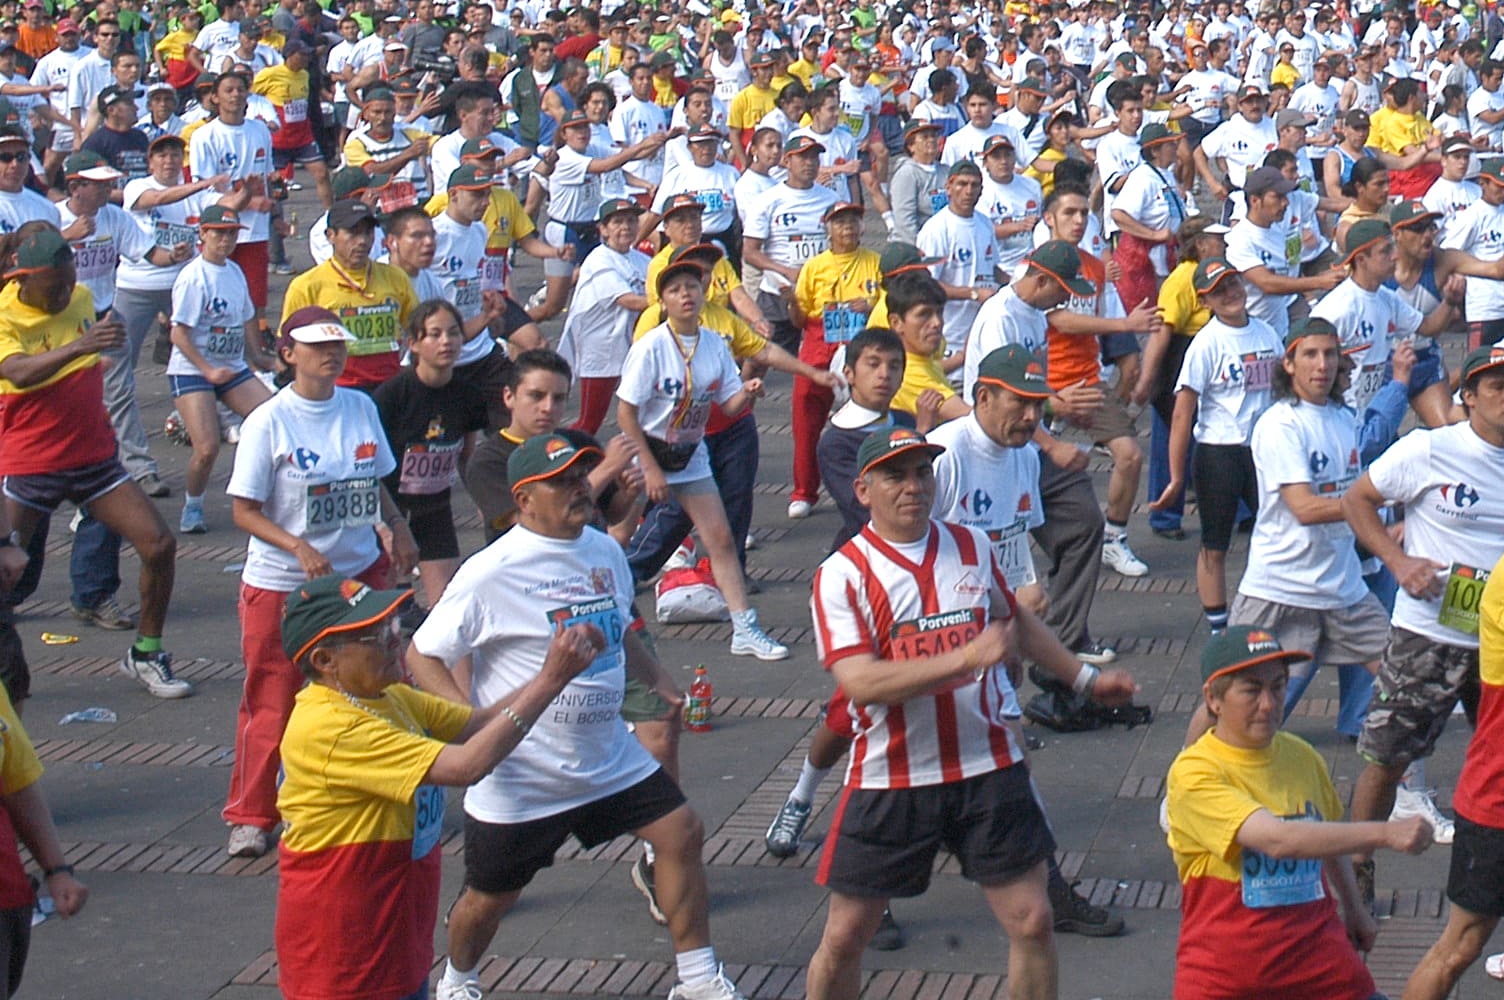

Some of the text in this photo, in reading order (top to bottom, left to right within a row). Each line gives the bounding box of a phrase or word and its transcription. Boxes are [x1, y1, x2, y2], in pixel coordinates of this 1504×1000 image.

[329, 479, 375, 493] Porvenir
[309, 491, 378, 525] 29388
[1436, 504, 1479, 521] Carrefour
[571, 599, 615, 617] Porvenir
[918, 610, 972, 631] Porvenir
[554, 712, 573, 724] EL
